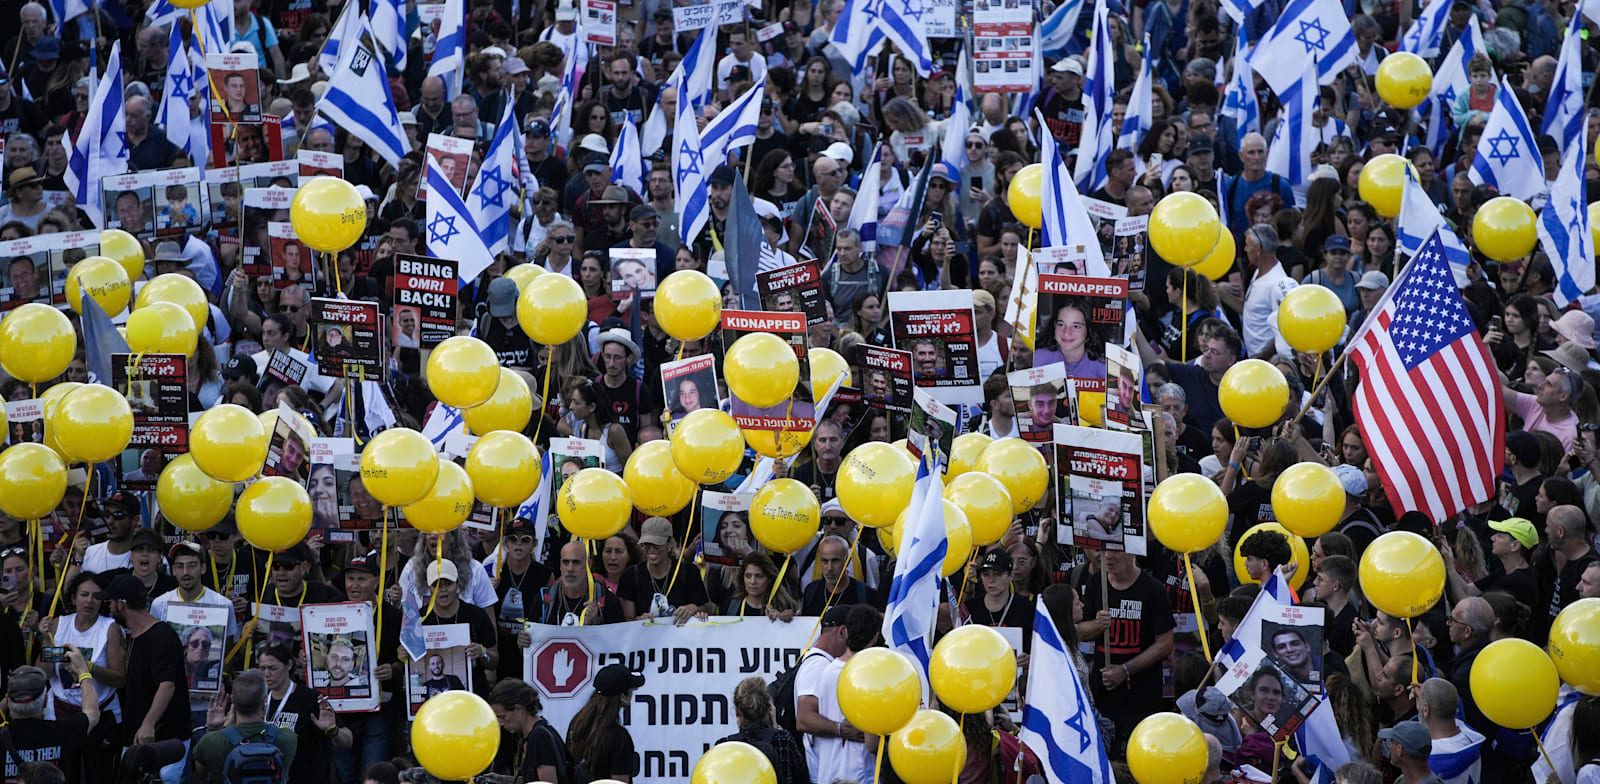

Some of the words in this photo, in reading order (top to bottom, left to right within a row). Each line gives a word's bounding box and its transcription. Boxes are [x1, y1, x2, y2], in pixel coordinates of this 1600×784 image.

[262, 116, 281, 124] AMAS
[400, 260, 453, 279] BRING
[408, 277, 445, 292] OMRI
[1044, 280, 1122, 295] KIDNAPPED
[400, 289, 451, 308] BACK!
[726, 317, 801, 330] KIDNAPPED
[944, 321, 961, 333] לא
[1073, 379, 1099, 389] חטופ
[736, 416, 761, 427] בעזה
[798, 419, 814, 428] גלי
[1109, 465, 1128, 477] לא
[598, 647, 726, 674] הומניטרי
[739, 647, 801, 673] סיוע
[621, 693, 728, 725] תמור
[5, 749, 35, 763] BING
[36, 745, 62, 762] THEM
